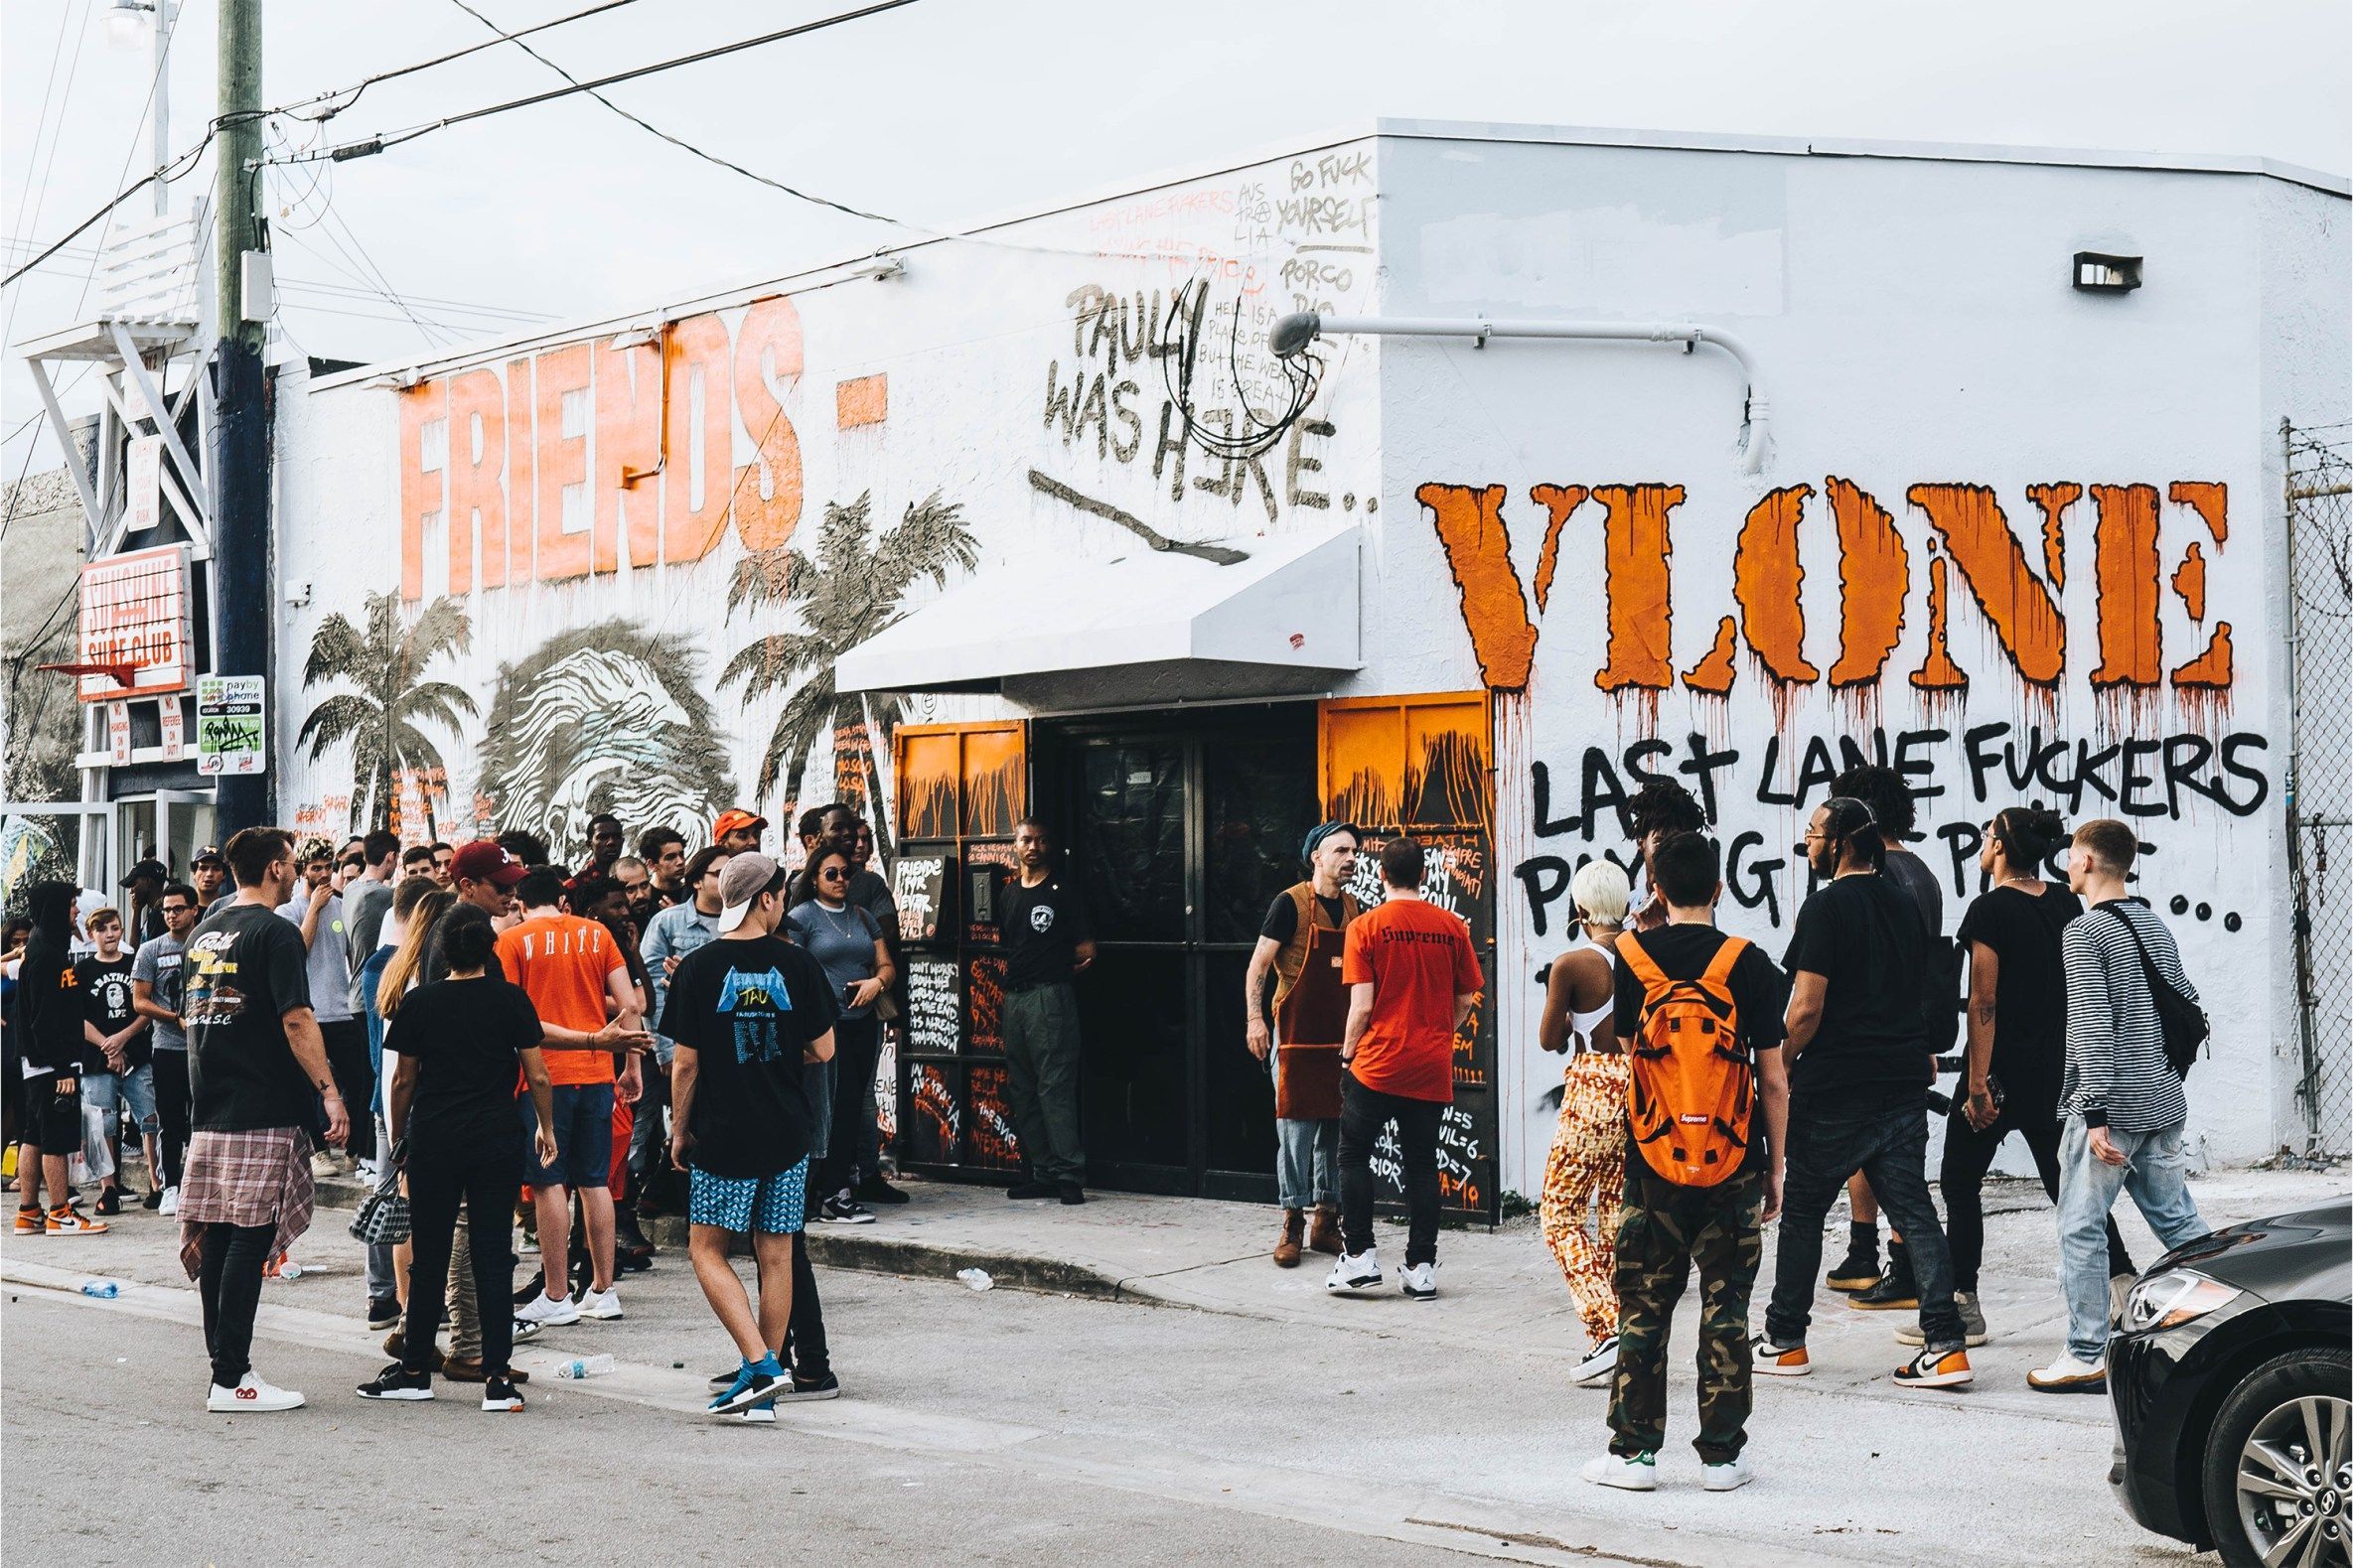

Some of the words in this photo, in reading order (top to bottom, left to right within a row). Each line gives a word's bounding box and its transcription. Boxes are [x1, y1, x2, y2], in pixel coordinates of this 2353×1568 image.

[1317, 152, 1375, 189] FUCK
[1276, 196, 1379, 238] YOURSELF
[1280, 258, 1354, 293] PORCO
[1044, 358, 1142, 464] WAS
[398, 295, 805, 603] FRIENDS
[89, 558, 173, 637] SUNSHINE
[1414, 474, 2235, 695] VLONE
[131, 631, 173, 666] CLUB
[1964, 721, 2270, 821] FUCKERS
[522, 924, 602, 962] WHITE
[1681, 1113, 1708, 1124] Supreme
